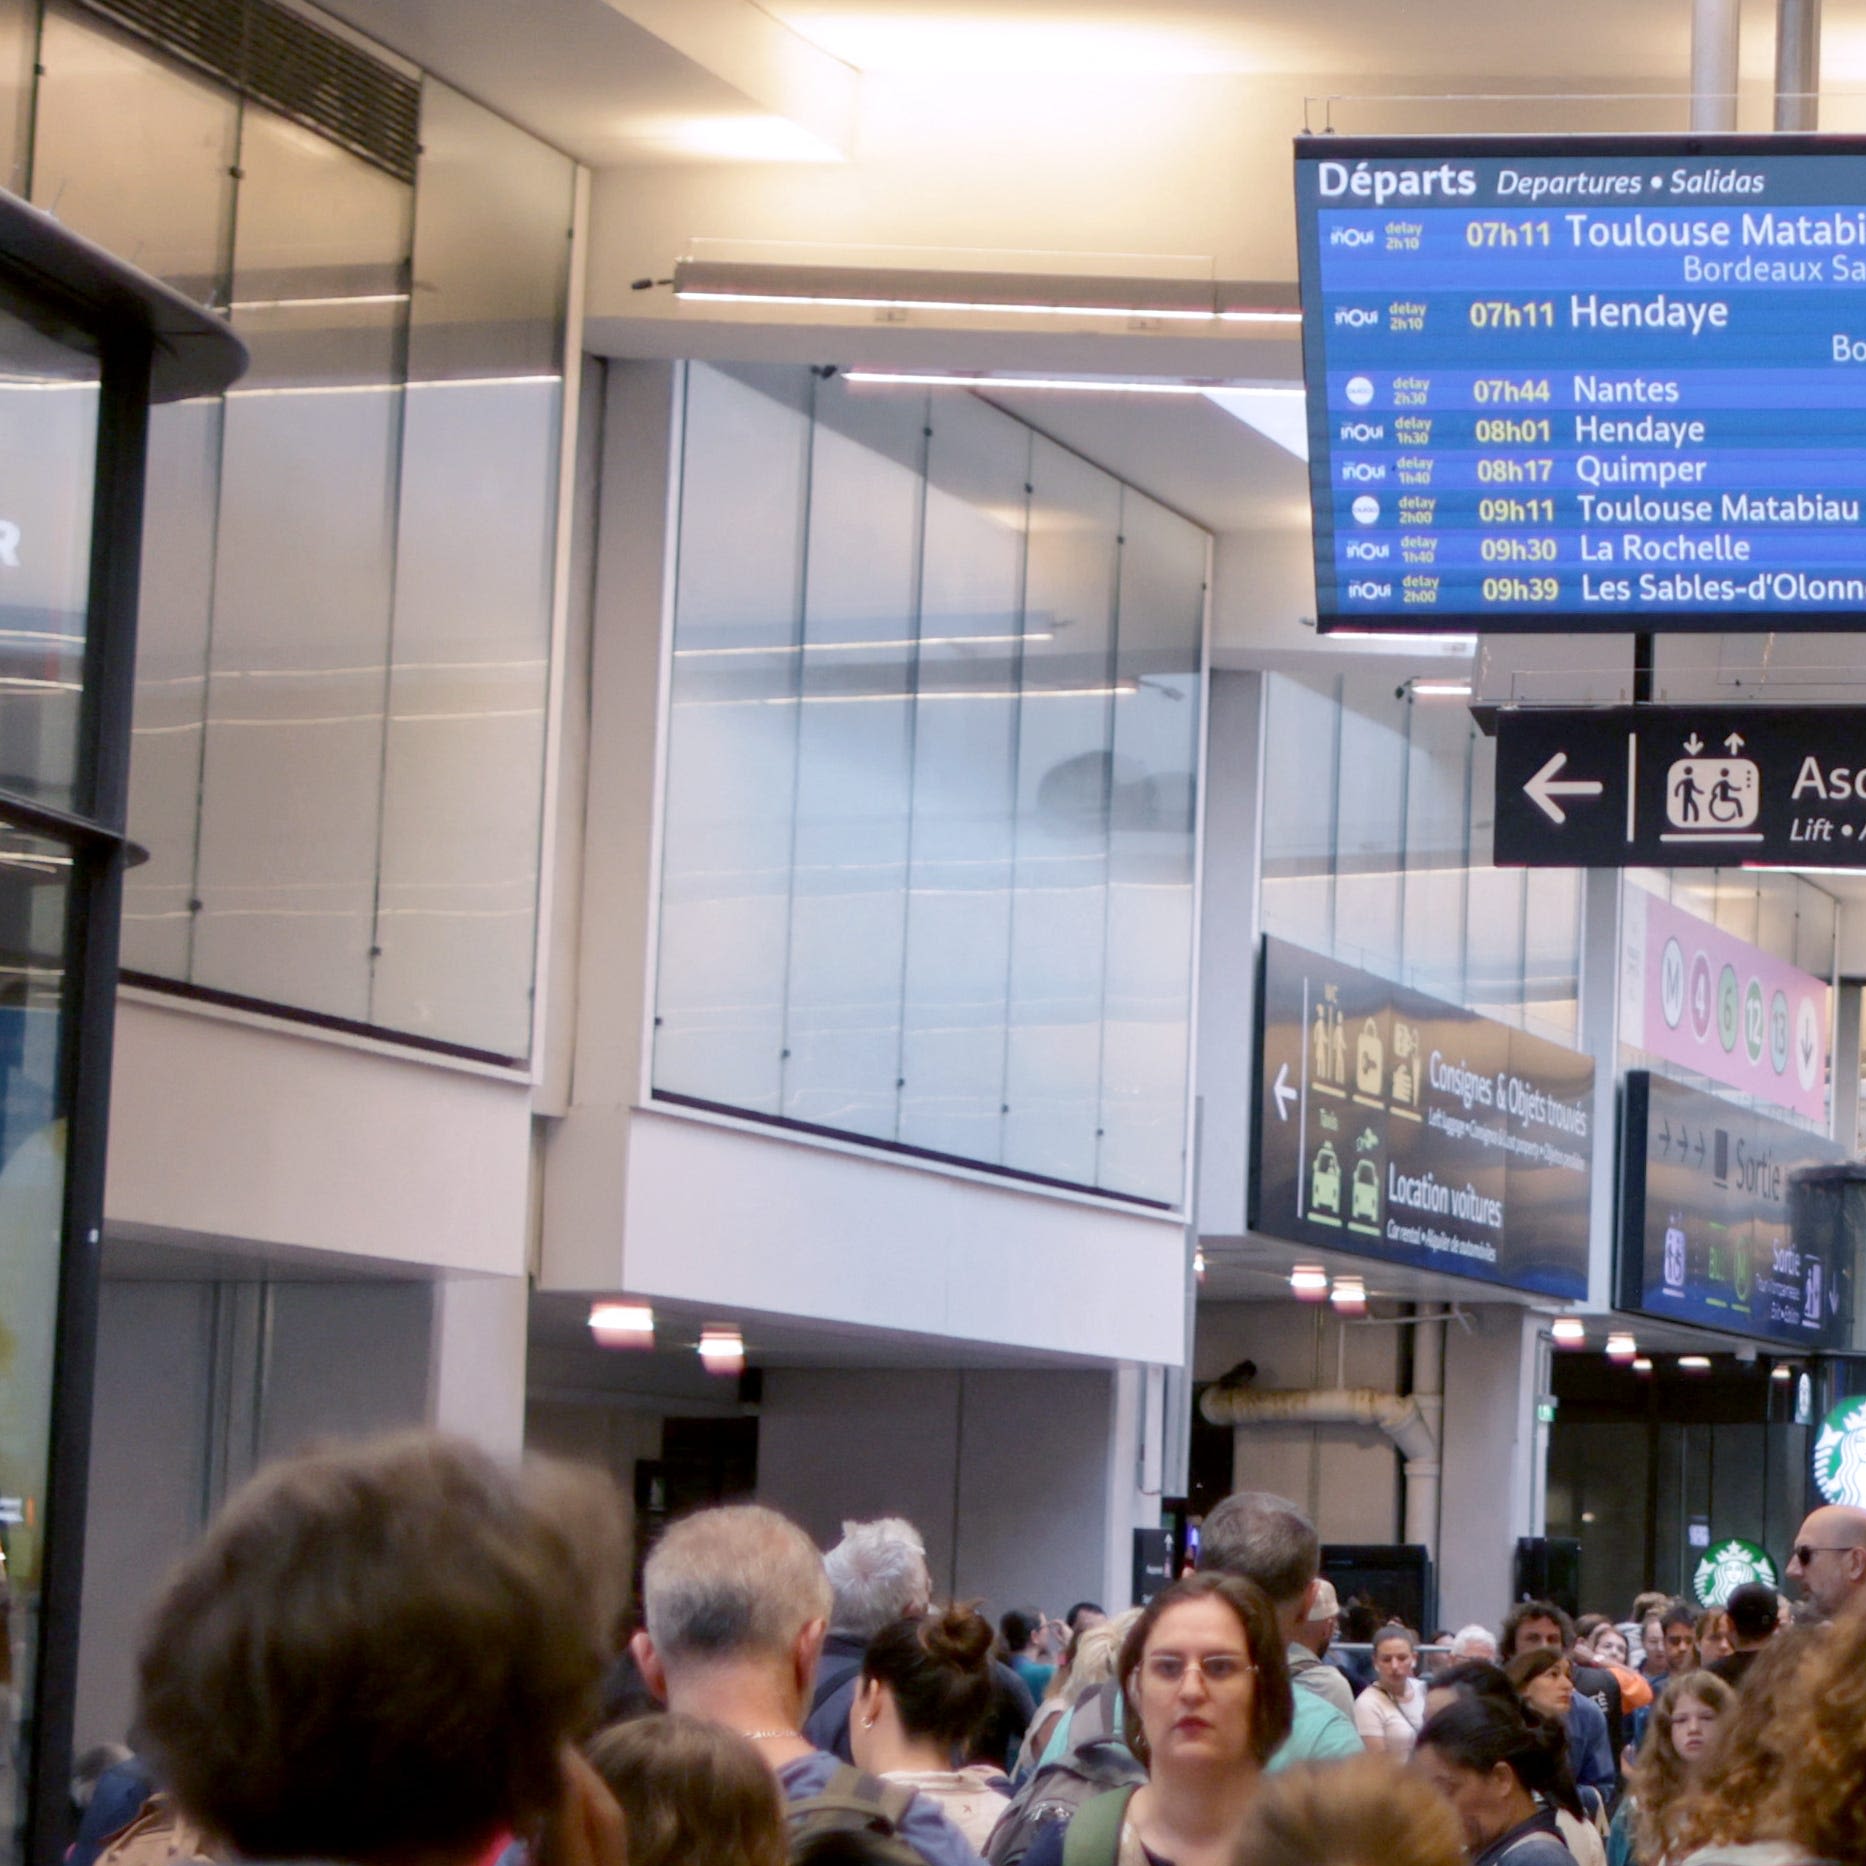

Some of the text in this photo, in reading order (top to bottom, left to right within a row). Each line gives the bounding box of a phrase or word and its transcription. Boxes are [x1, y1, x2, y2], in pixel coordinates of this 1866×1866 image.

[1319, 162, 1765, 204] Départs Departures Salidas
[1385, 222, 1423, 236] delay
[1466, 222, 1550, 247] 07h11
[1565, 214, 1730, 247] Toulouse
[1386, 238, 1420, 250] 2h10
[1684, 255, 1824, 283] Bordeaux
[1470, 295, 1729, 335] 07h11 Hendaye
[1393, 377, 1430, 391] delay
[1473, 380, 1551, 403] 07h44
[1573, 376, 1680, 403] Nantes
[1475, 416, 1705, 448] 08h01 Hendaye
[1477, 455, 1708, 488] 08h17 Quimper
[1479, 494, 1859, 522] 09h11 Toulouse Matabiau
[1480, 534, 1751, 561] 09h30 La Rochelle
[1482, 578, 1559, 601] 09h39
[1583, 574, 1635, 601] Les
[1790, 816, 1834, 843] Lift
[1429, 1050, 1492, 1109] Consignes
[1496, 1073, 1507, 1110] &
[1508, 1076, 1546, 1127] Objets
[1547, 1094, 1587, 1137] trouvés
[1736, 1138, 1780, 1201] Sortie
[1389, 1161, 1502, 1228] Location voitures
